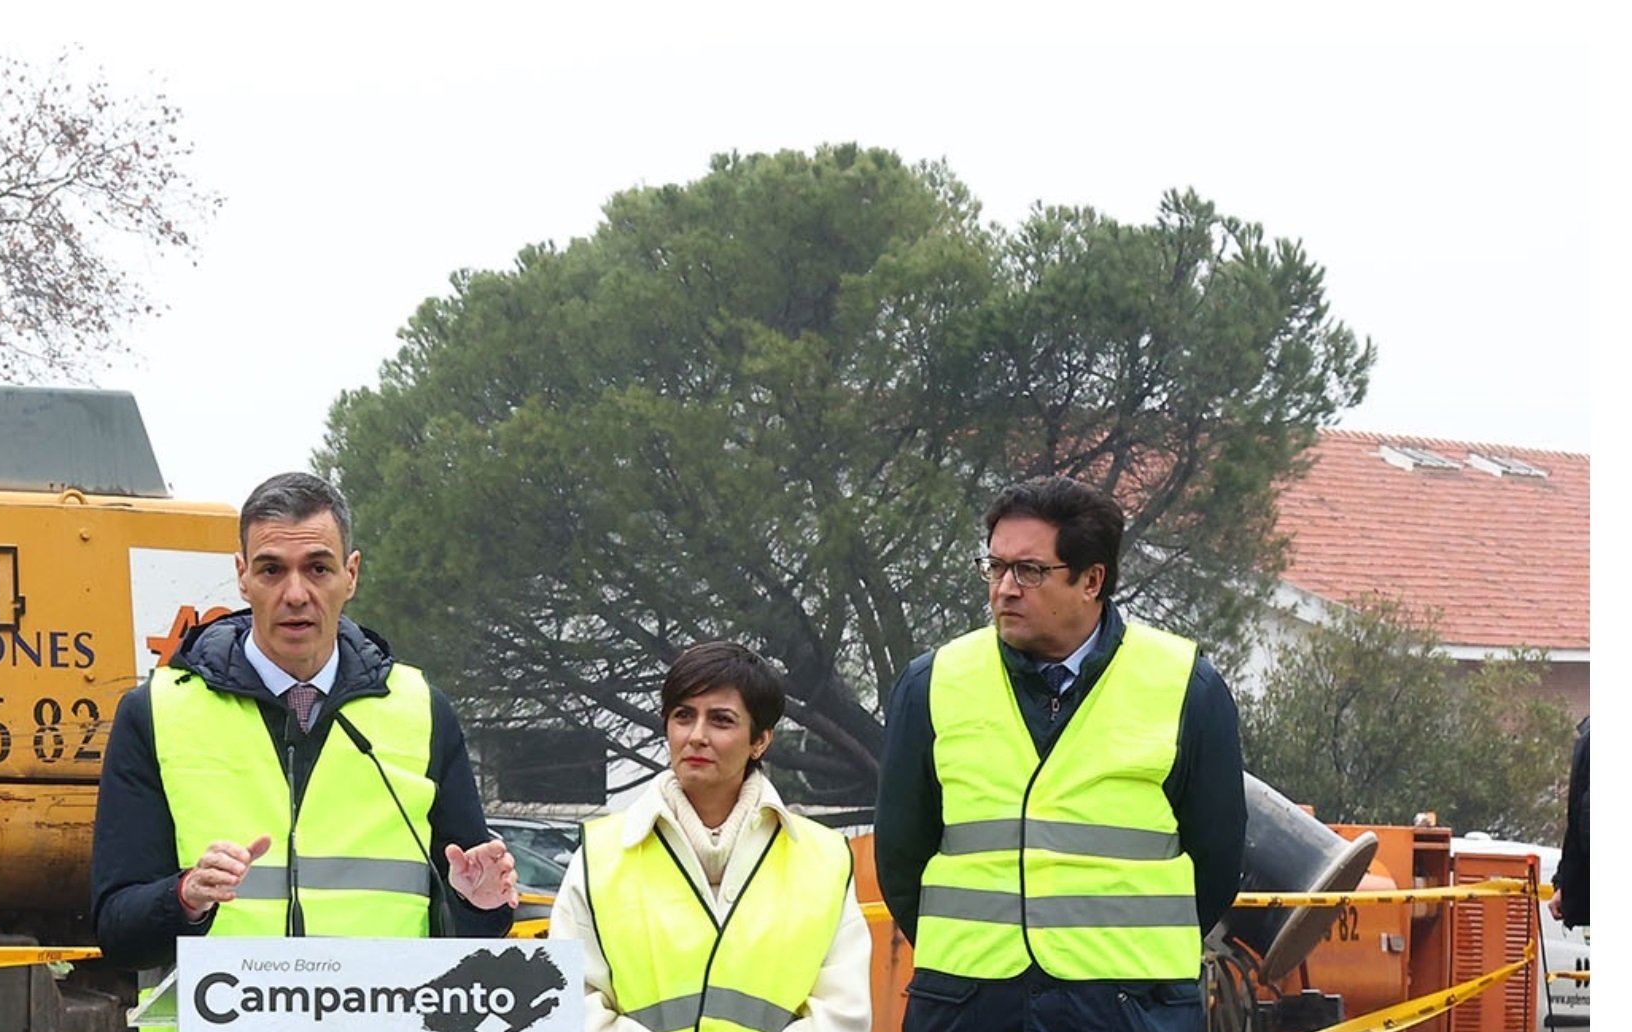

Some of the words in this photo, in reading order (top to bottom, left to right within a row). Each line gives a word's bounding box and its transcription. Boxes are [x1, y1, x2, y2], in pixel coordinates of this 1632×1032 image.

[33, 698, 102, 763] 82
[241, 958, 290, 972] Nuevo
[294, 958, 342, 972] Barrio
[194, 971, 517, 1025] Campamento
